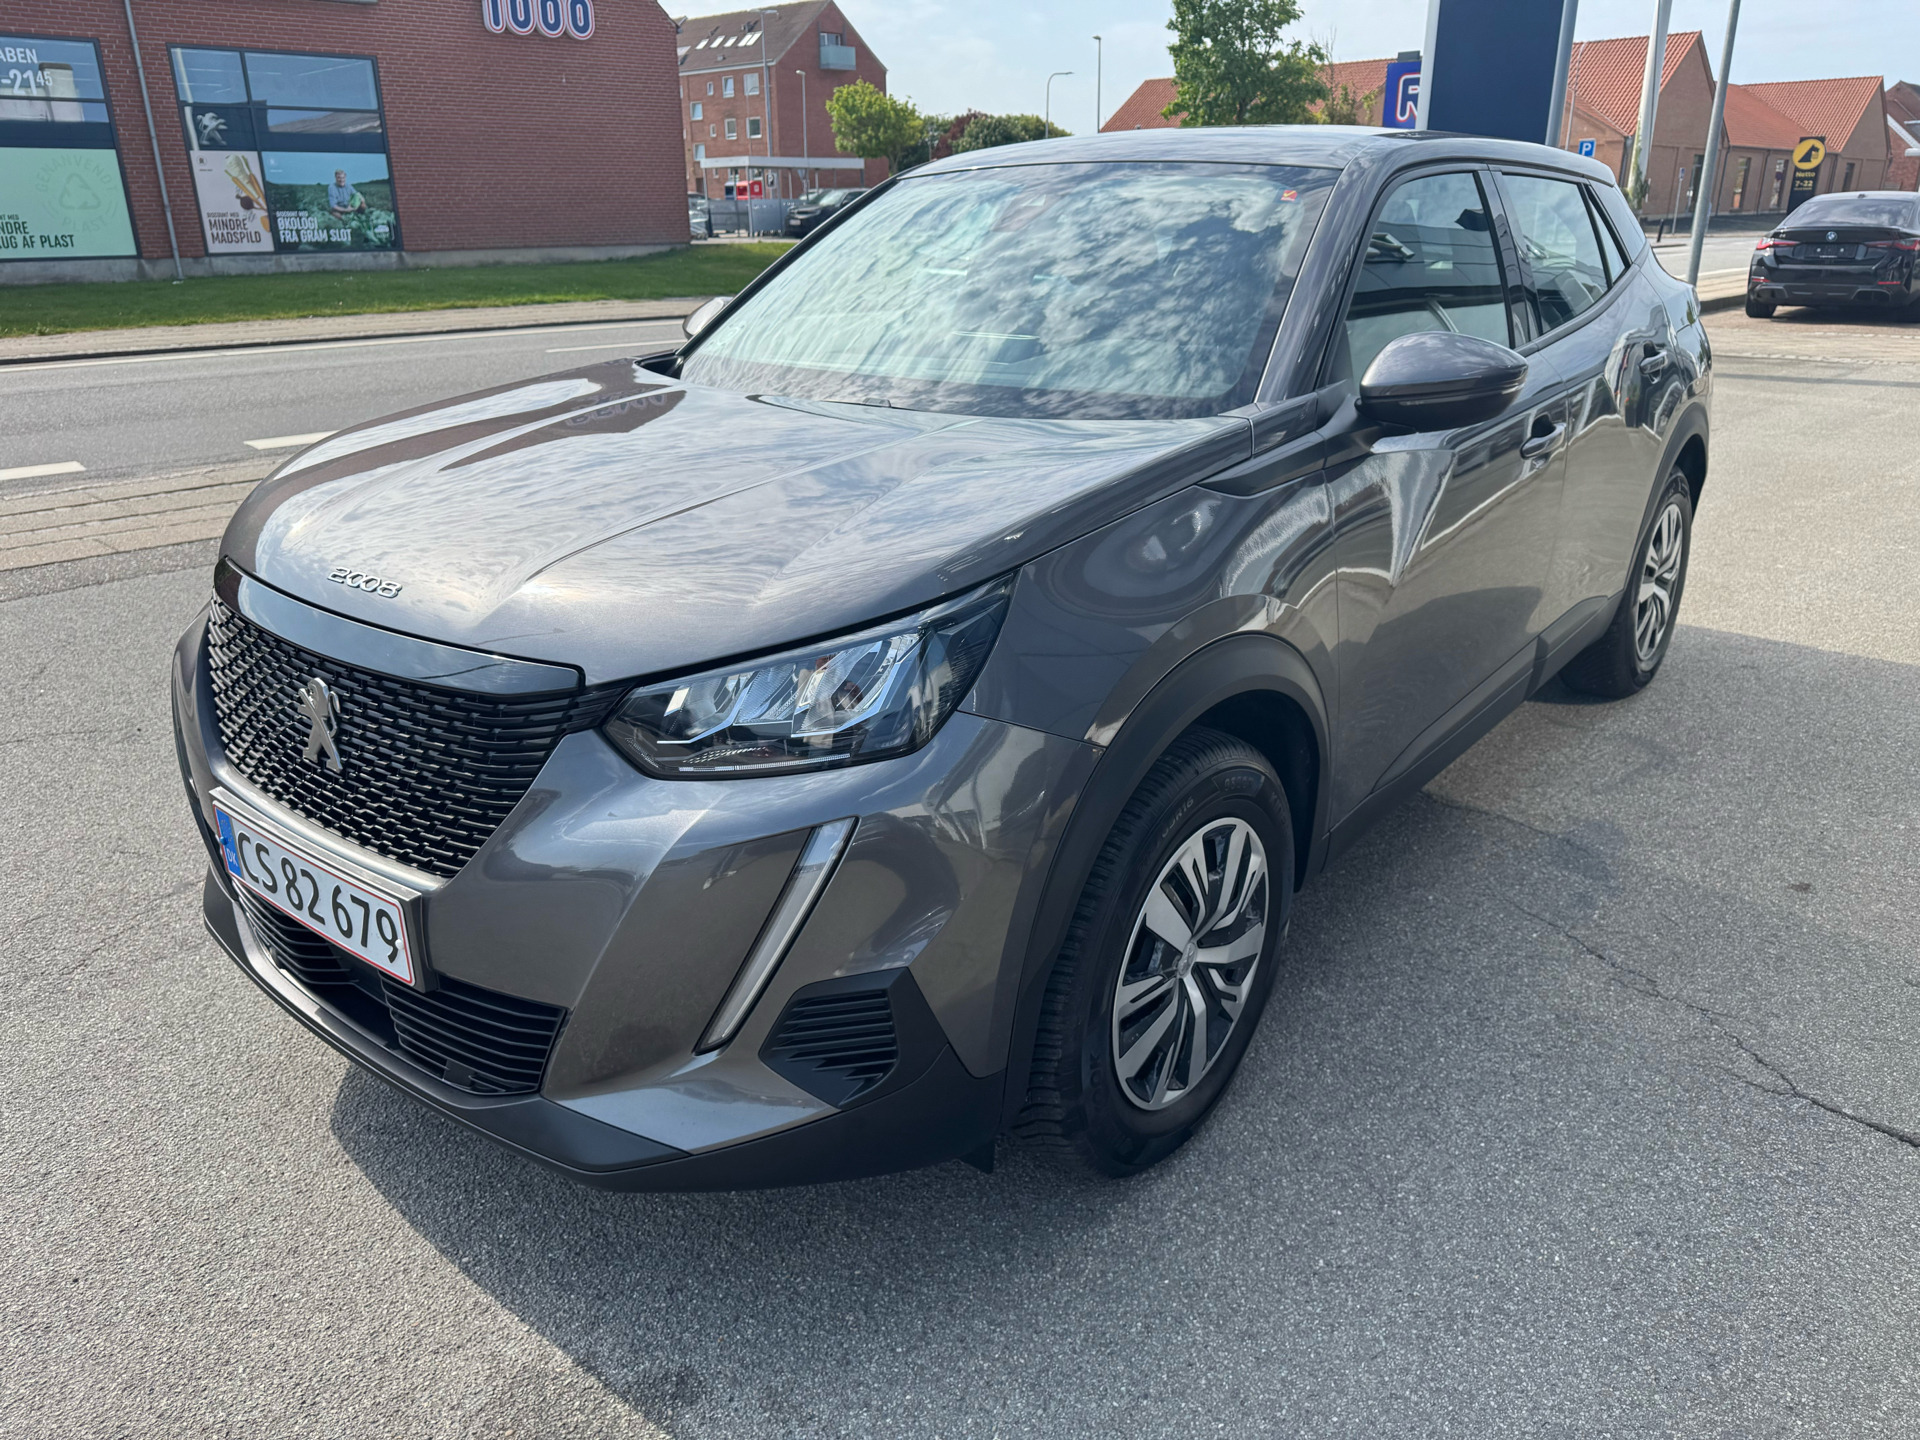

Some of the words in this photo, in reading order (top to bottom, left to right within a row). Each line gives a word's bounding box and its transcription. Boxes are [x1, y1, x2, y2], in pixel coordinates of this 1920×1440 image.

[1582, 142, 1592, 156] P
[208, 218, 248, 231] MINDRE
[277, 217, 318, 230] ØKOLOGI
[23, 235, 36, 248] AF
[40, 235, 75, 248] PLAST
[211, 231, 262, 244] MADSPILD
[280, 230, 299, 243] FRA
[300, 230, 328, 242] GRAM
[329, 229, 352, 242] SLOT
[327, 566, 403, 599] 2008
[226, 848, 239, 867] DK
